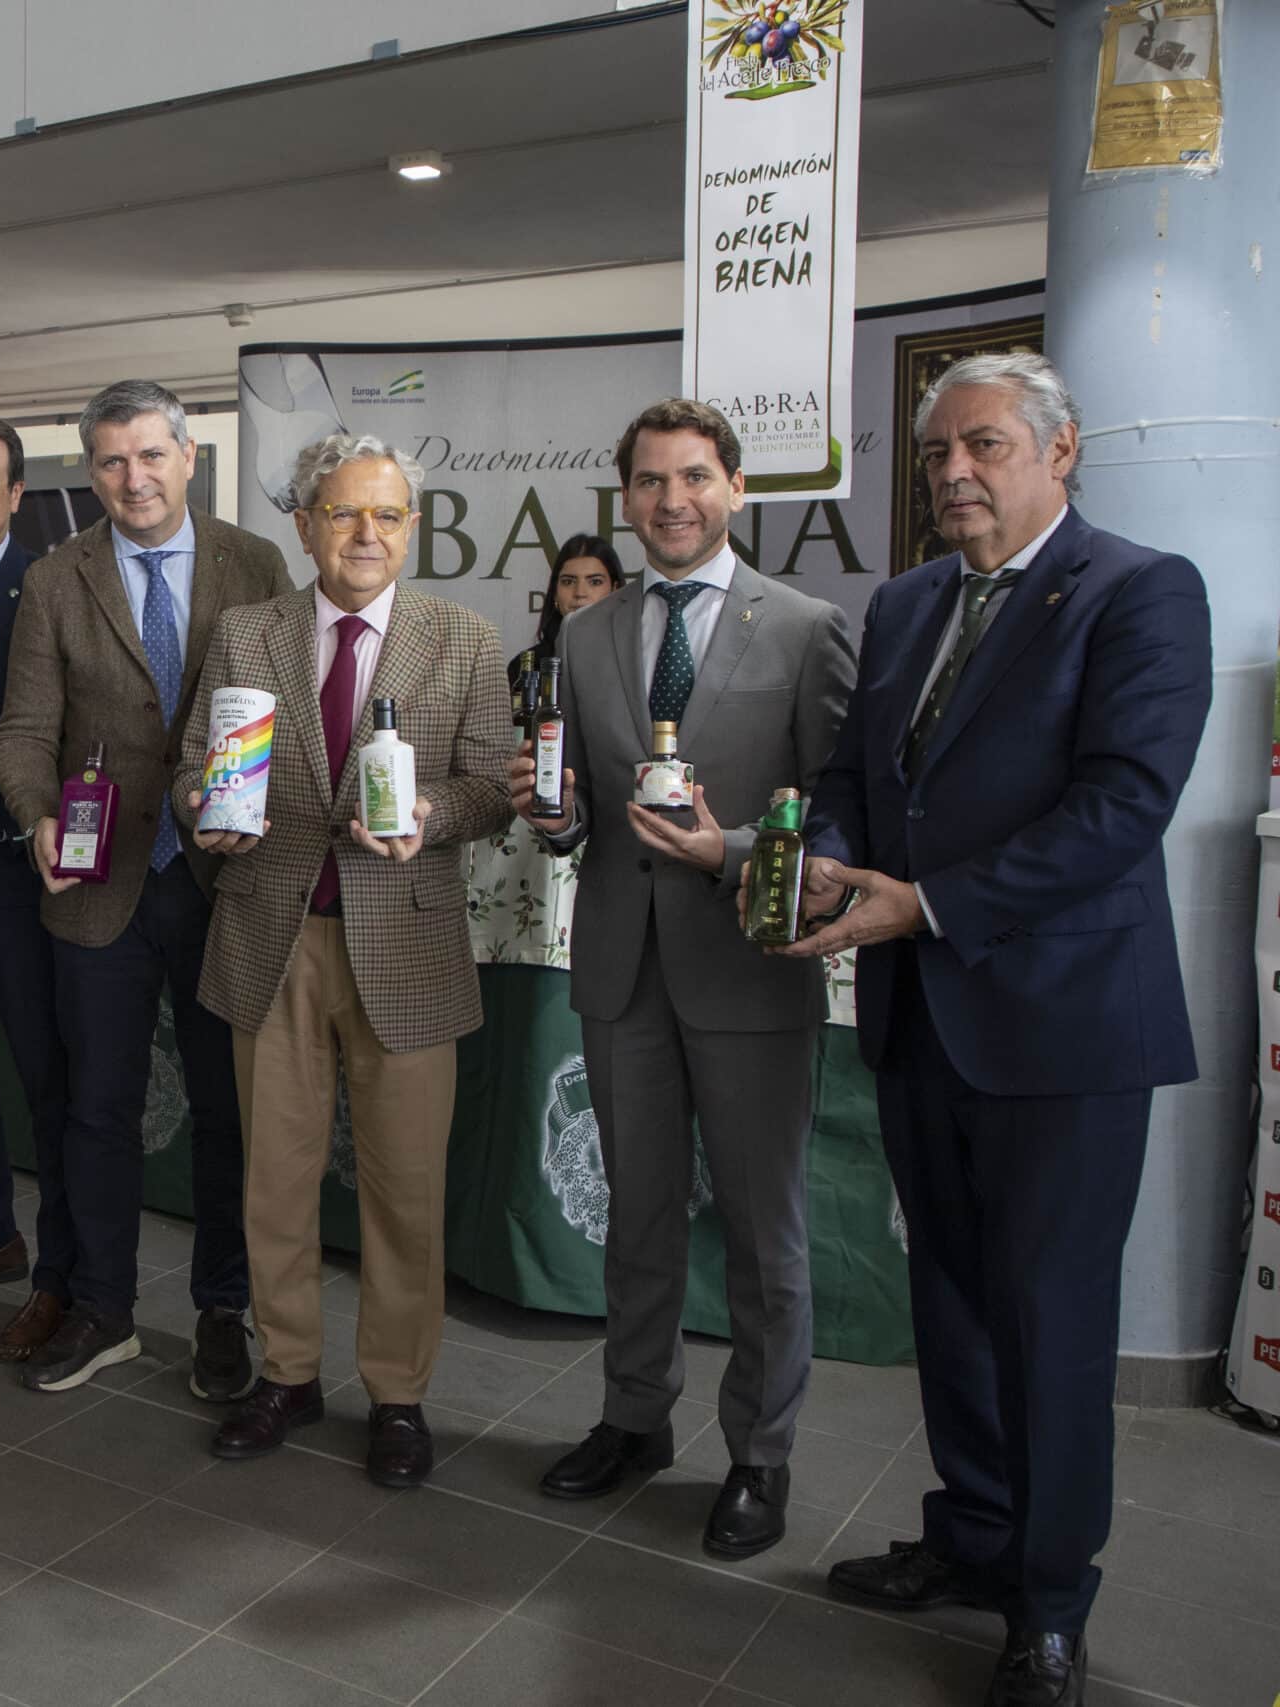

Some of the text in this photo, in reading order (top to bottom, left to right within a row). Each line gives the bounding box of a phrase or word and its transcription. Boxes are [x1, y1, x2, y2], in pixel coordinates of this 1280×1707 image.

[699, 56, 831, 92] del Aceite Fresco
[704, 152, 833, 189] DENOMINACIÓN
[746, 191, 778, 216] DE
[715, 213, 810, 252] ORIGEN
[715, 249, 813, 293] BAENA
[352, 386, 381, 397] Europa
[740, 418, 820, 433] RDOBA
[766, 432, 820, 441] NOVIEMBRE
[752, 441, 824, 453] VEINTICINCO
